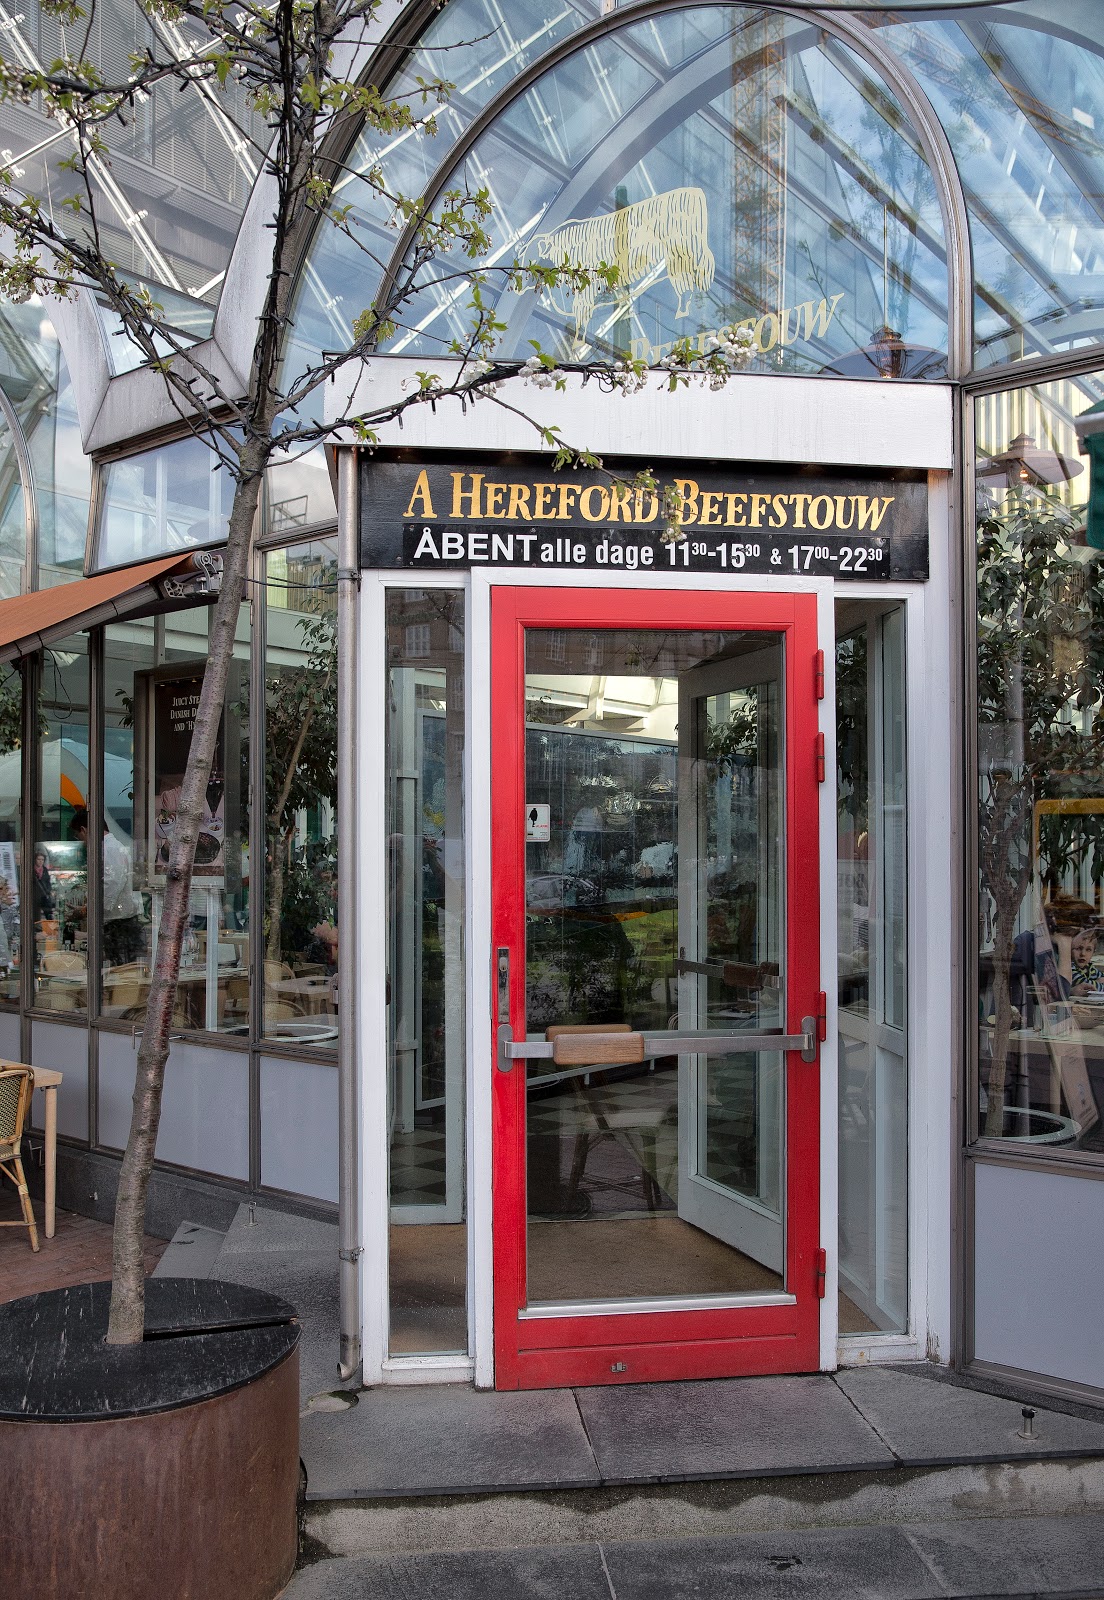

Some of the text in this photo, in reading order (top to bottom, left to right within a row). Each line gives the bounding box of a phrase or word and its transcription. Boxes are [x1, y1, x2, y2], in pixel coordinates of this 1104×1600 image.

[403, 469, 895, 531] A HEREFORD BEEFSTOUW
[414, 527, 538, 561] ÅBENT
[540, 538, 586, 563] alle
[595, 540, 653, 569] dage
[770, 548, 782, 565] &
[189, 695, 201, 704] STE
